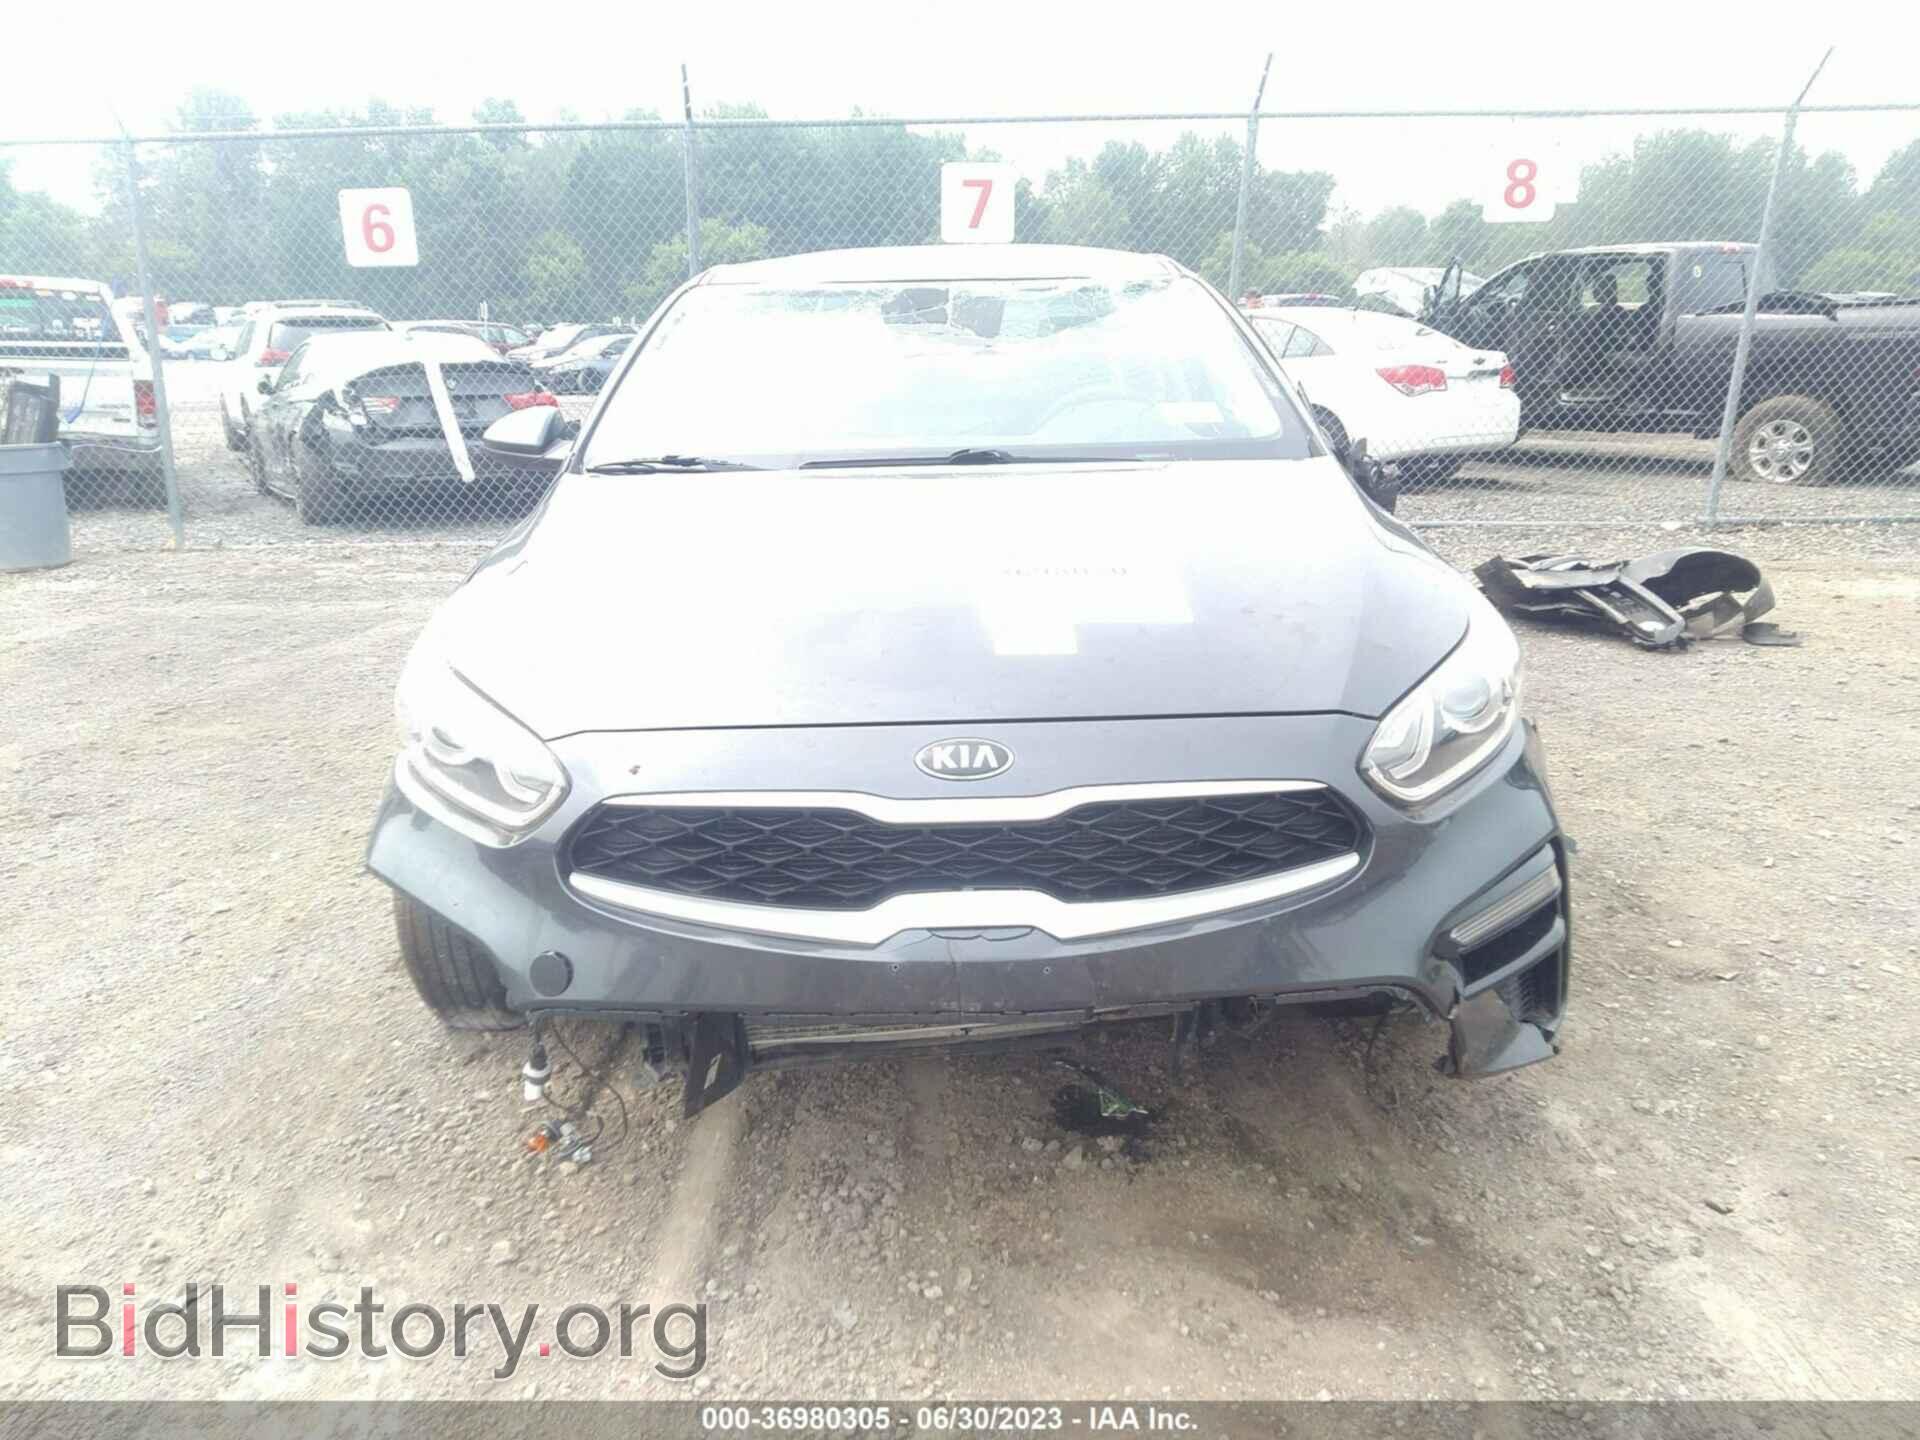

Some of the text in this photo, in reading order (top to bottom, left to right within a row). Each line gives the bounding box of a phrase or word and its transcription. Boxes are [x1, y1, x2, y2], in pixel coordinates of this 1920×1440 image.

[962, 179, 993, 229] 7
[1503, 159, 1537, 209] 8
[361, 204, 396, 253] 6
[930, 744, 999, 769] KIA
